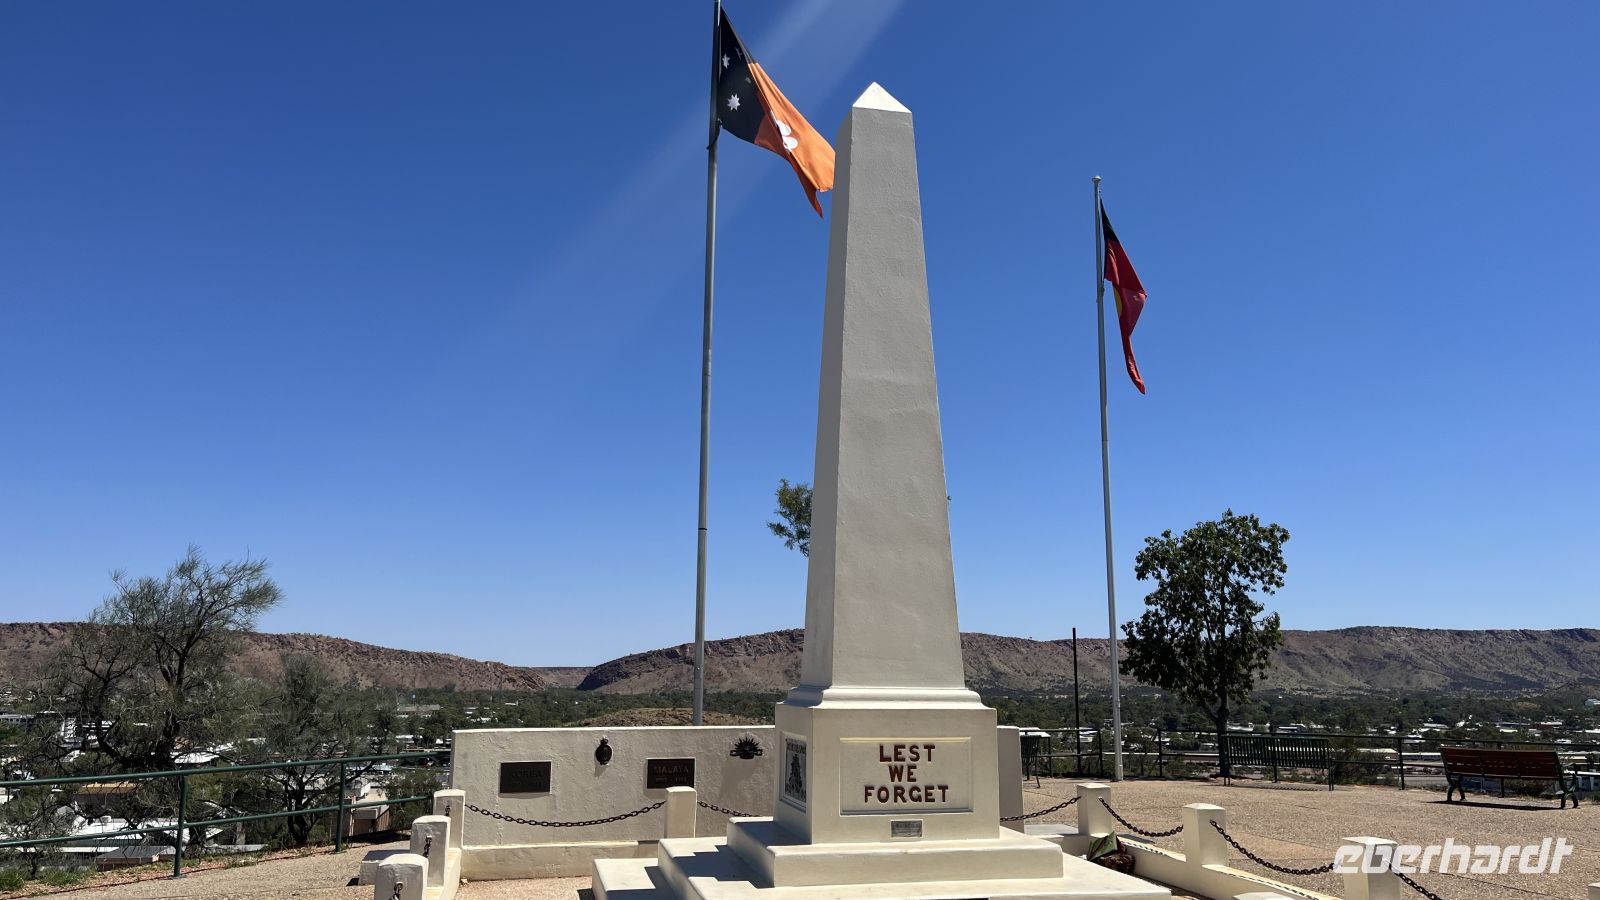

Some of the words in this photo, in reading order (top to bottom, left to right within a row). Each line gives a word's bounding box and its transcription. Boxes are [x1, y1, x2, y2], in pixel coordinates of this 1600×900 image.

[879, 744, 935, 762] LEST
[889, 765, 917, 782] WE
[864, 784, 948, 803] FORGET
